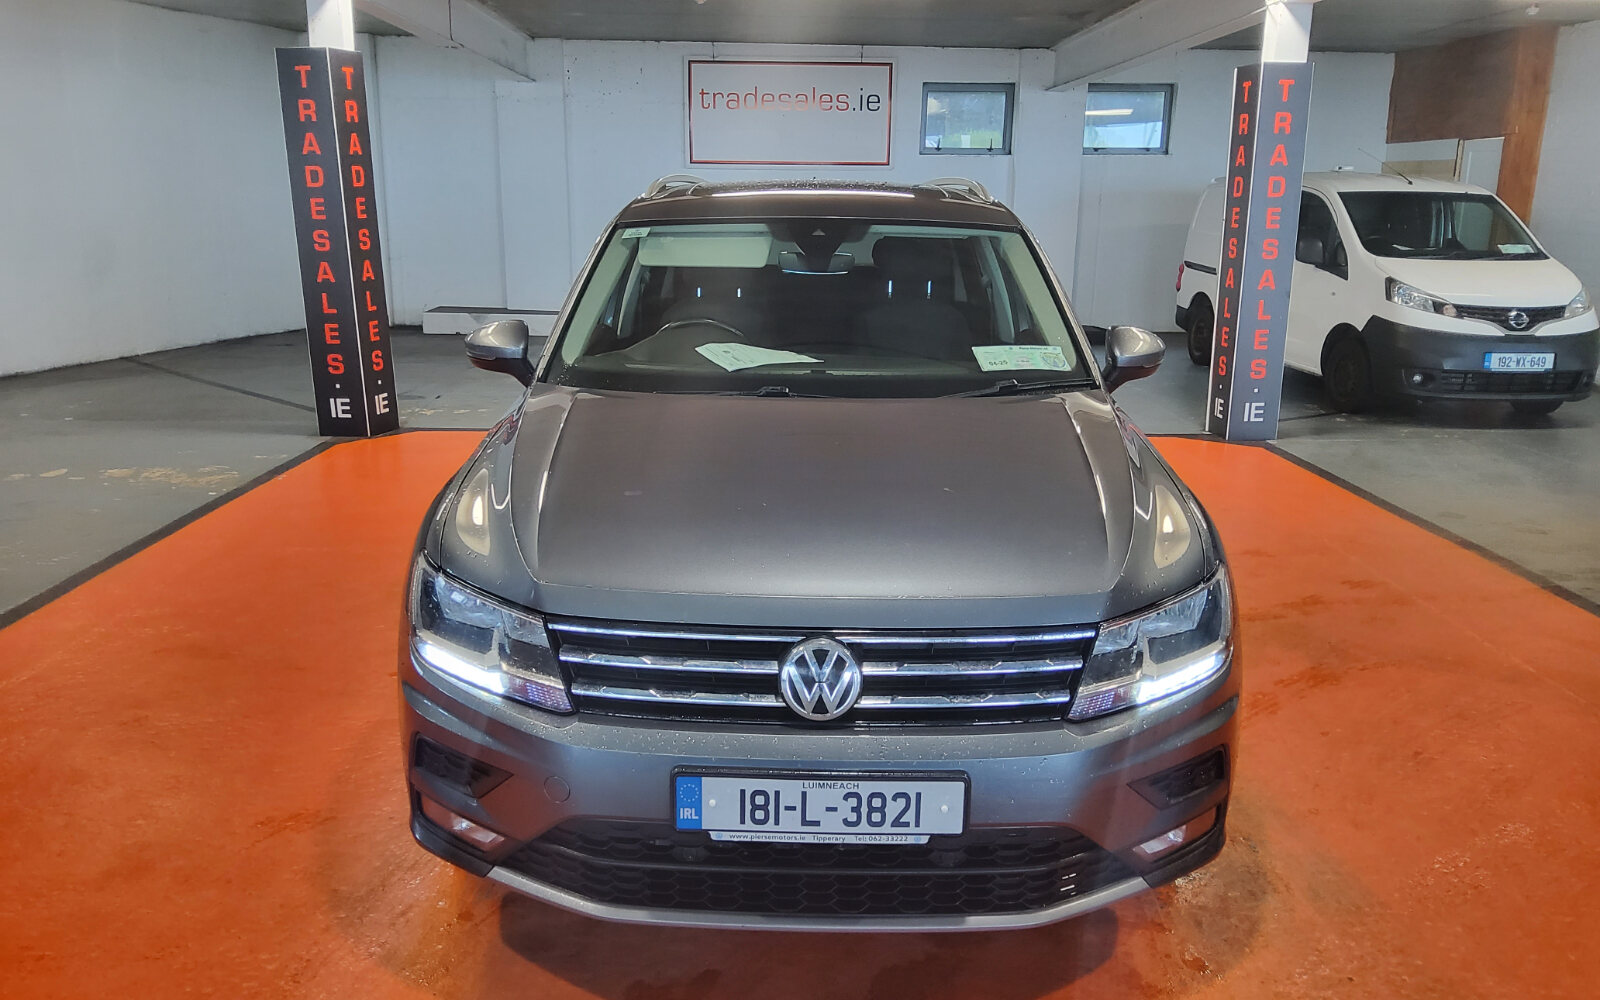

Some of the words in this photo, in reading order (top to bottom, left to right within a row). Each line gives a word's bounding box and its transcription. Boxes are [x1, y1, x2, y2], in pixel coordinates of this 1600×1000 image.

[699, 86, 881, 112] tradesales.ie
[1498, 356, 1547, 368] 192-WX-649
[802, 781, 860, 790] LUIMNEACH
[680, 808, 699, 820] IRL
[739, 788, 922, 828] 181-L-3821
[729, 833, 806, 841] www.piersemotors.ie
